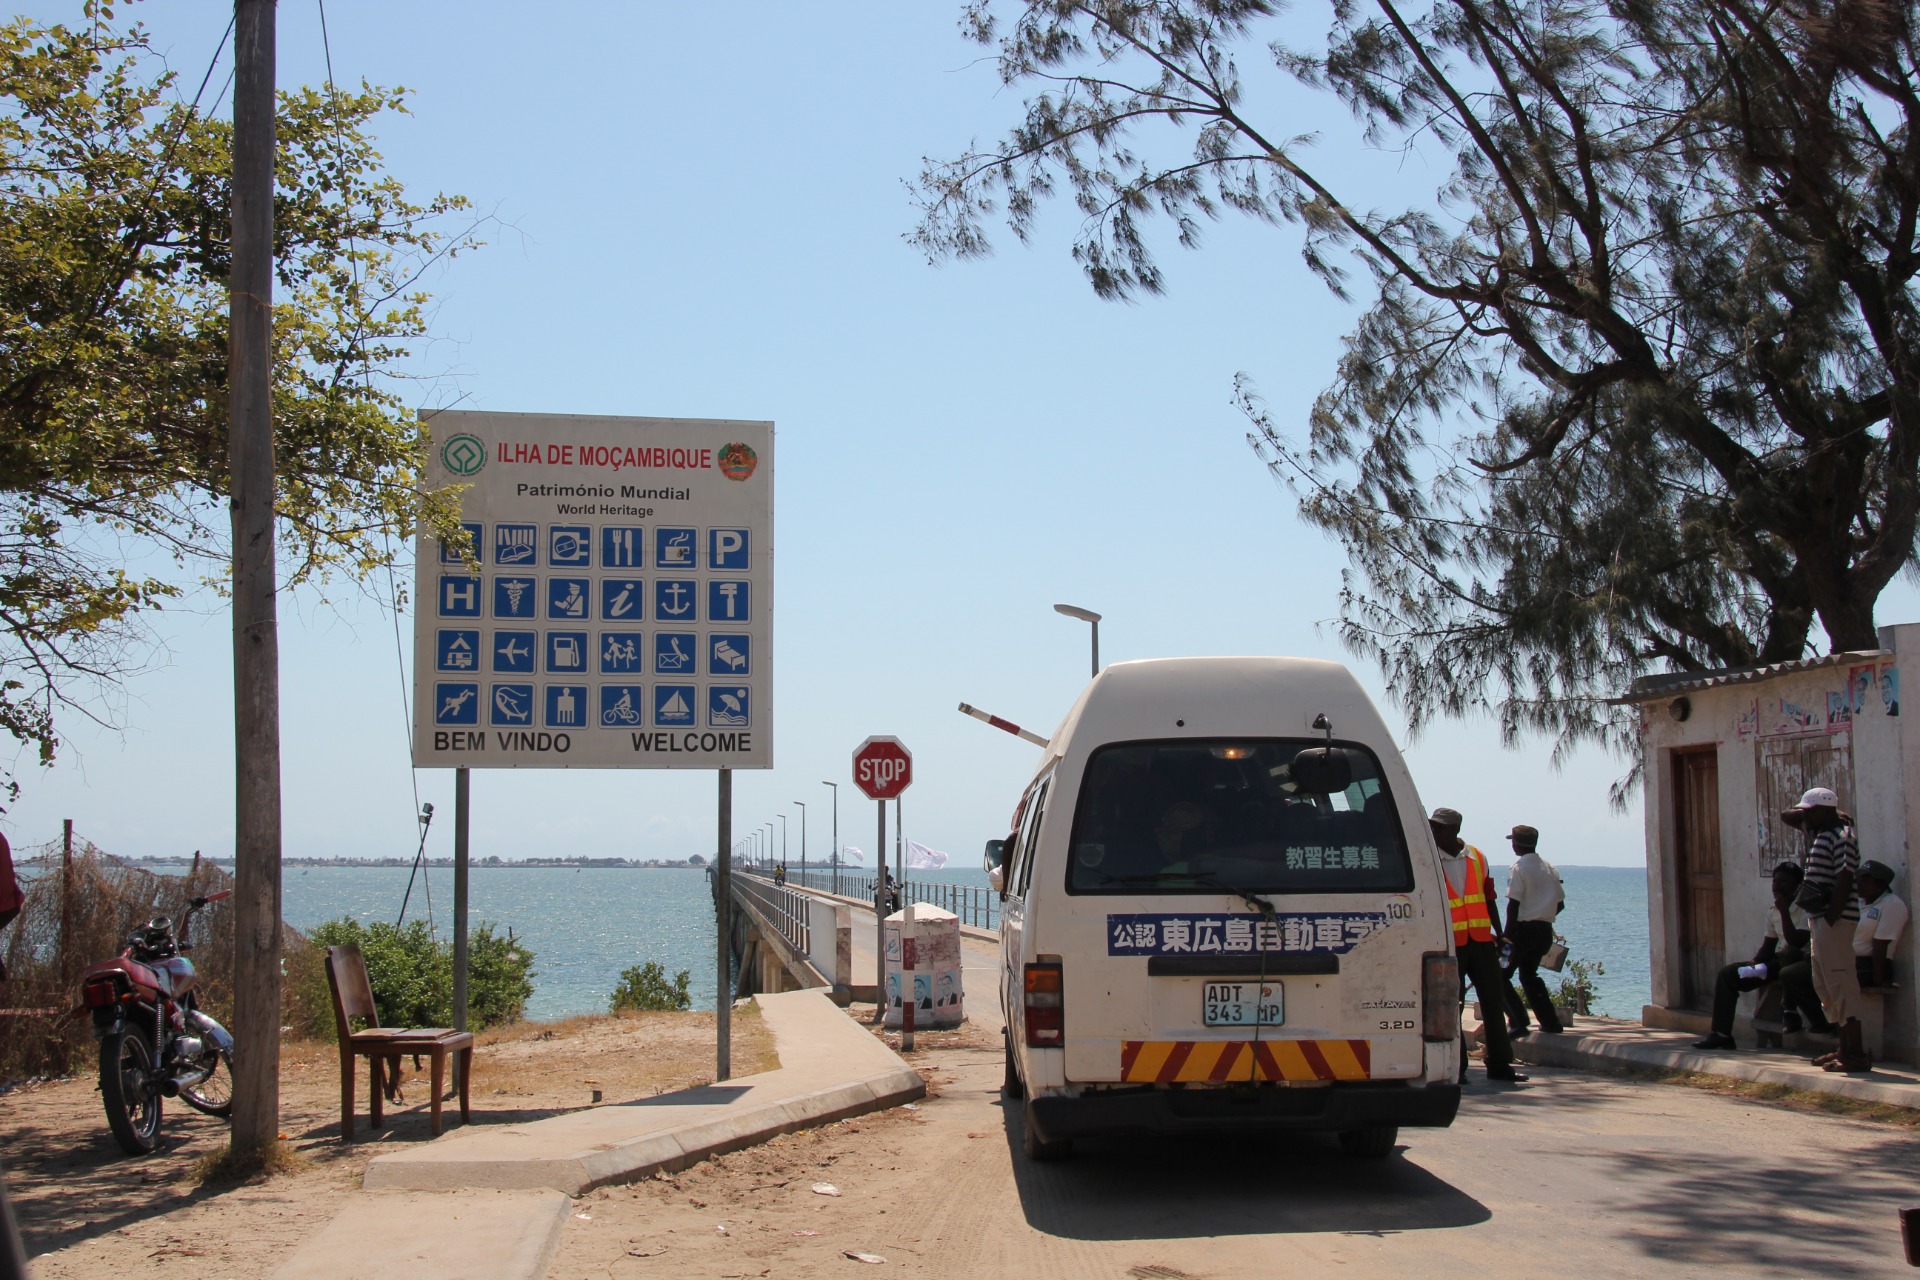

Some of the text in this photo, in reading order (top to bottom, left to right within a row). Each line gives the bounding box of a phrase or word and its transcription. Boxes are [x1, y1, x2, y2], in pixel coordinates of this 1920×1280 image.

[498, 442, 542, 464] ILHA
[547, 444, 573, 466] DE
[579, 446, 712, 471] MOÇAMBIQUE
[517, 483, 690, 501] Património Mundial
[557, 504, 654, 518] World Heritage
[716, 531, 742, 565] P
[446, 583, 474, 610] H
[434, 731, 571, 753] BEM VINDO
[631, 732, 752, 752] WELCOME
[860, 758, 906, 781] STOP
[1285, 846, 1379, 870] 教習生募集
[1386, 903, 1412, 919] 100
[1207, 985, 1243, 1002] ADT
[1207, 1004, 1243, 1022] 343
[1379, 1020, 1415, 1030] 3.2D
